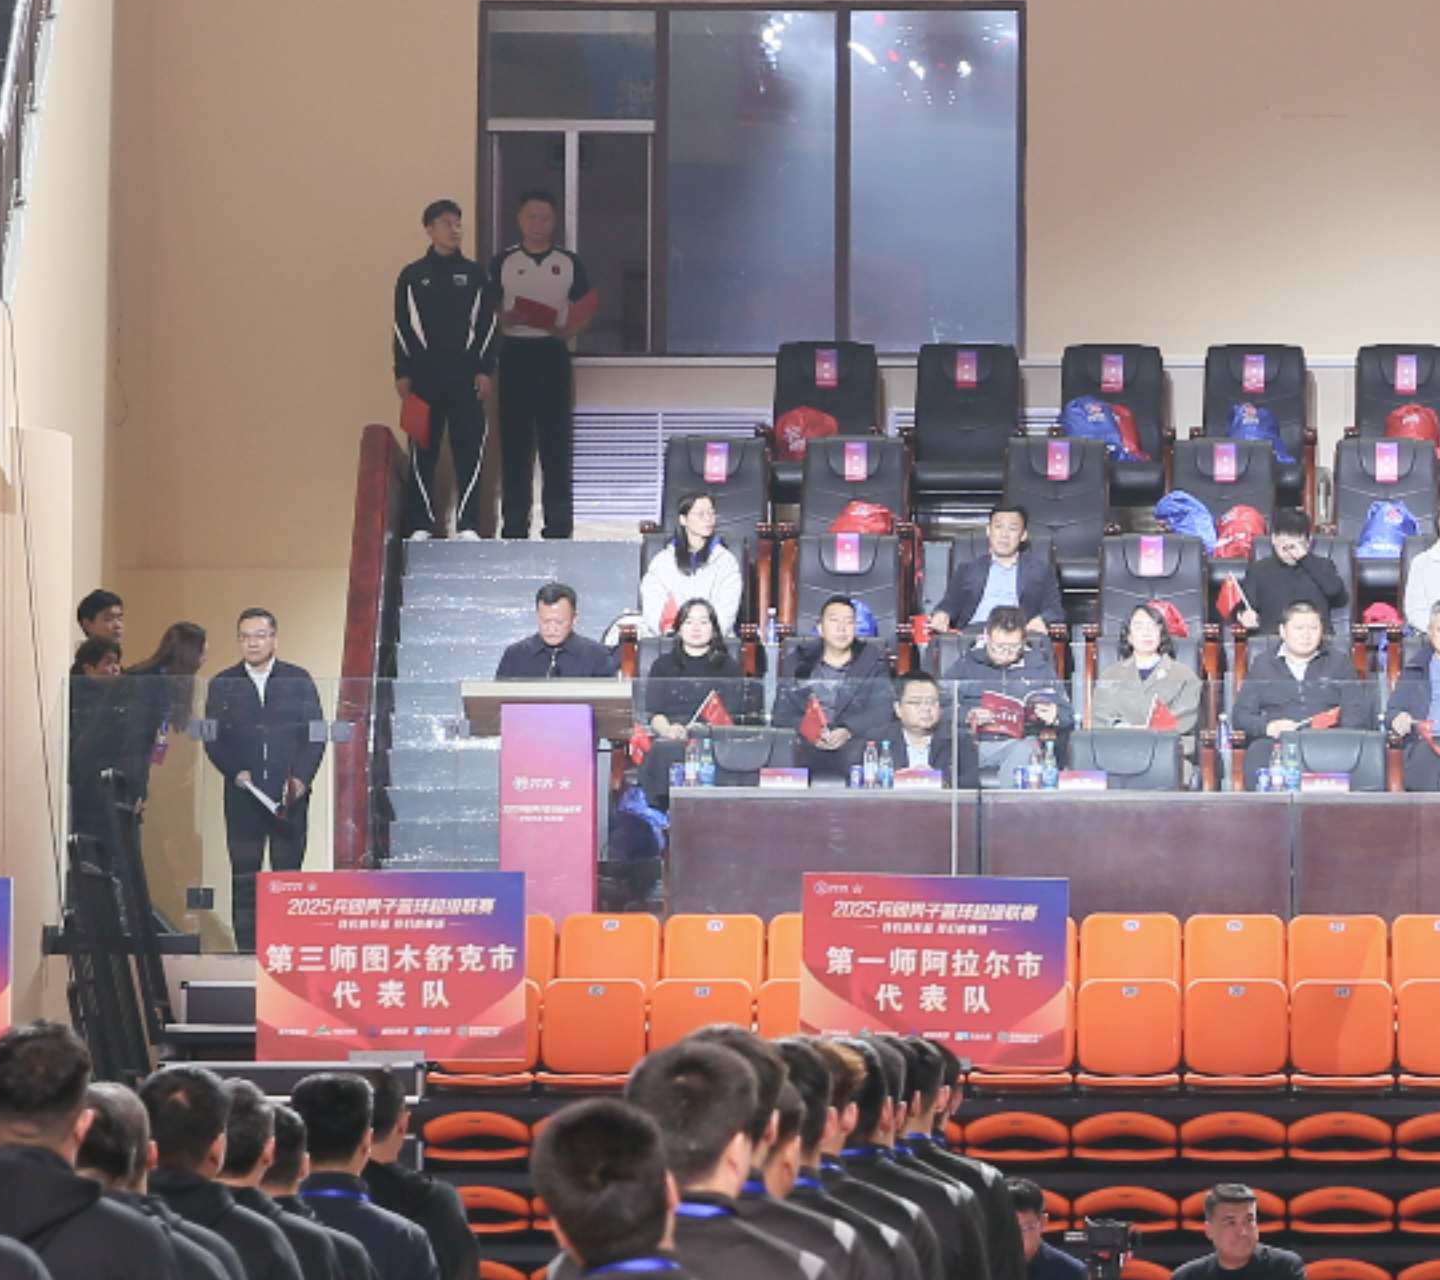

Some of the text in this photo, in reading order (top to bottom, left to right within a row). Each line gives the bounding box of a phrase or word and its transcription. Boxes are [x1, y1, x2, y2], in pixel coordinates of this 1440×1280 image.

[266, 943, 517, 974] 第三师图木舒克市
[825, 945, 1044, 980] 第一师阿拉尔市
[332, 980, 451, 1009] 代表队
[875, 983, 991, 1014] 代表队
